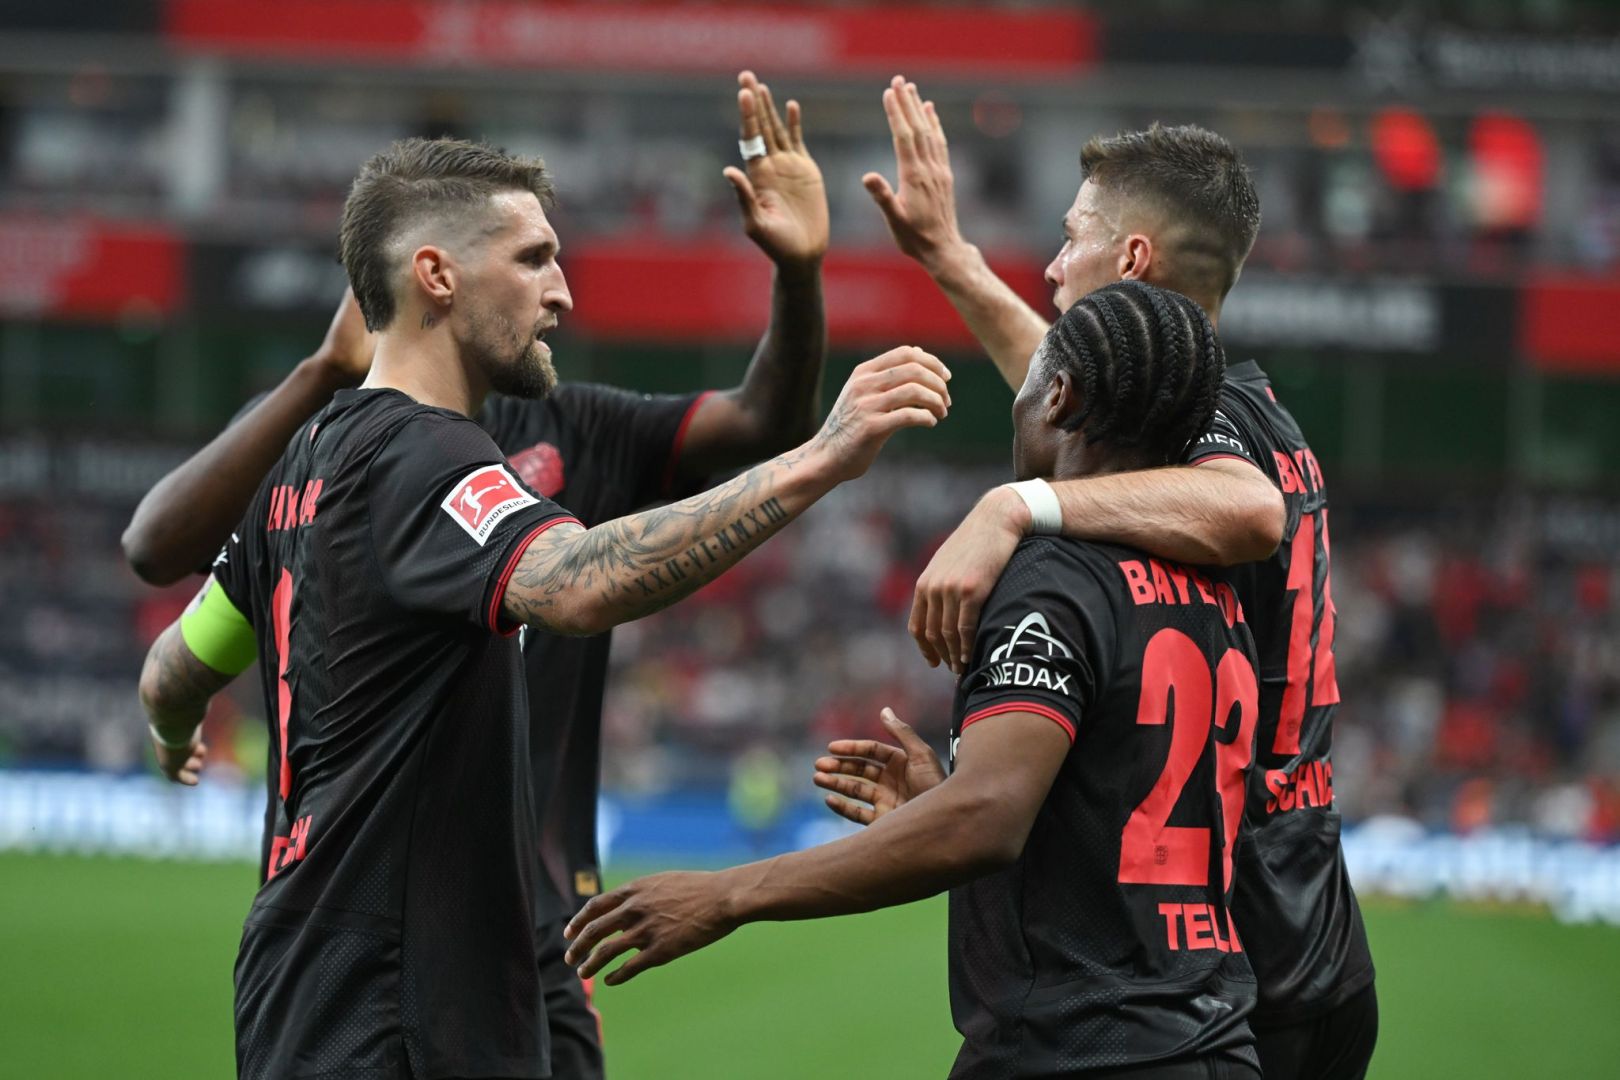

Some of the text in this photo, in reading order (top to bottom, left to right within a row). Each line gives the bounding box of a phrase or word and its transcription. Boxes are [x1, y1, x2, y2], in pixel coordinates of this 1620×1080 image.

[478, 499, 530, 538] BUNDESLIGA
[980, 661, 1072, 696] NIEDAX
[1117, 626, 1259, 893] 23
